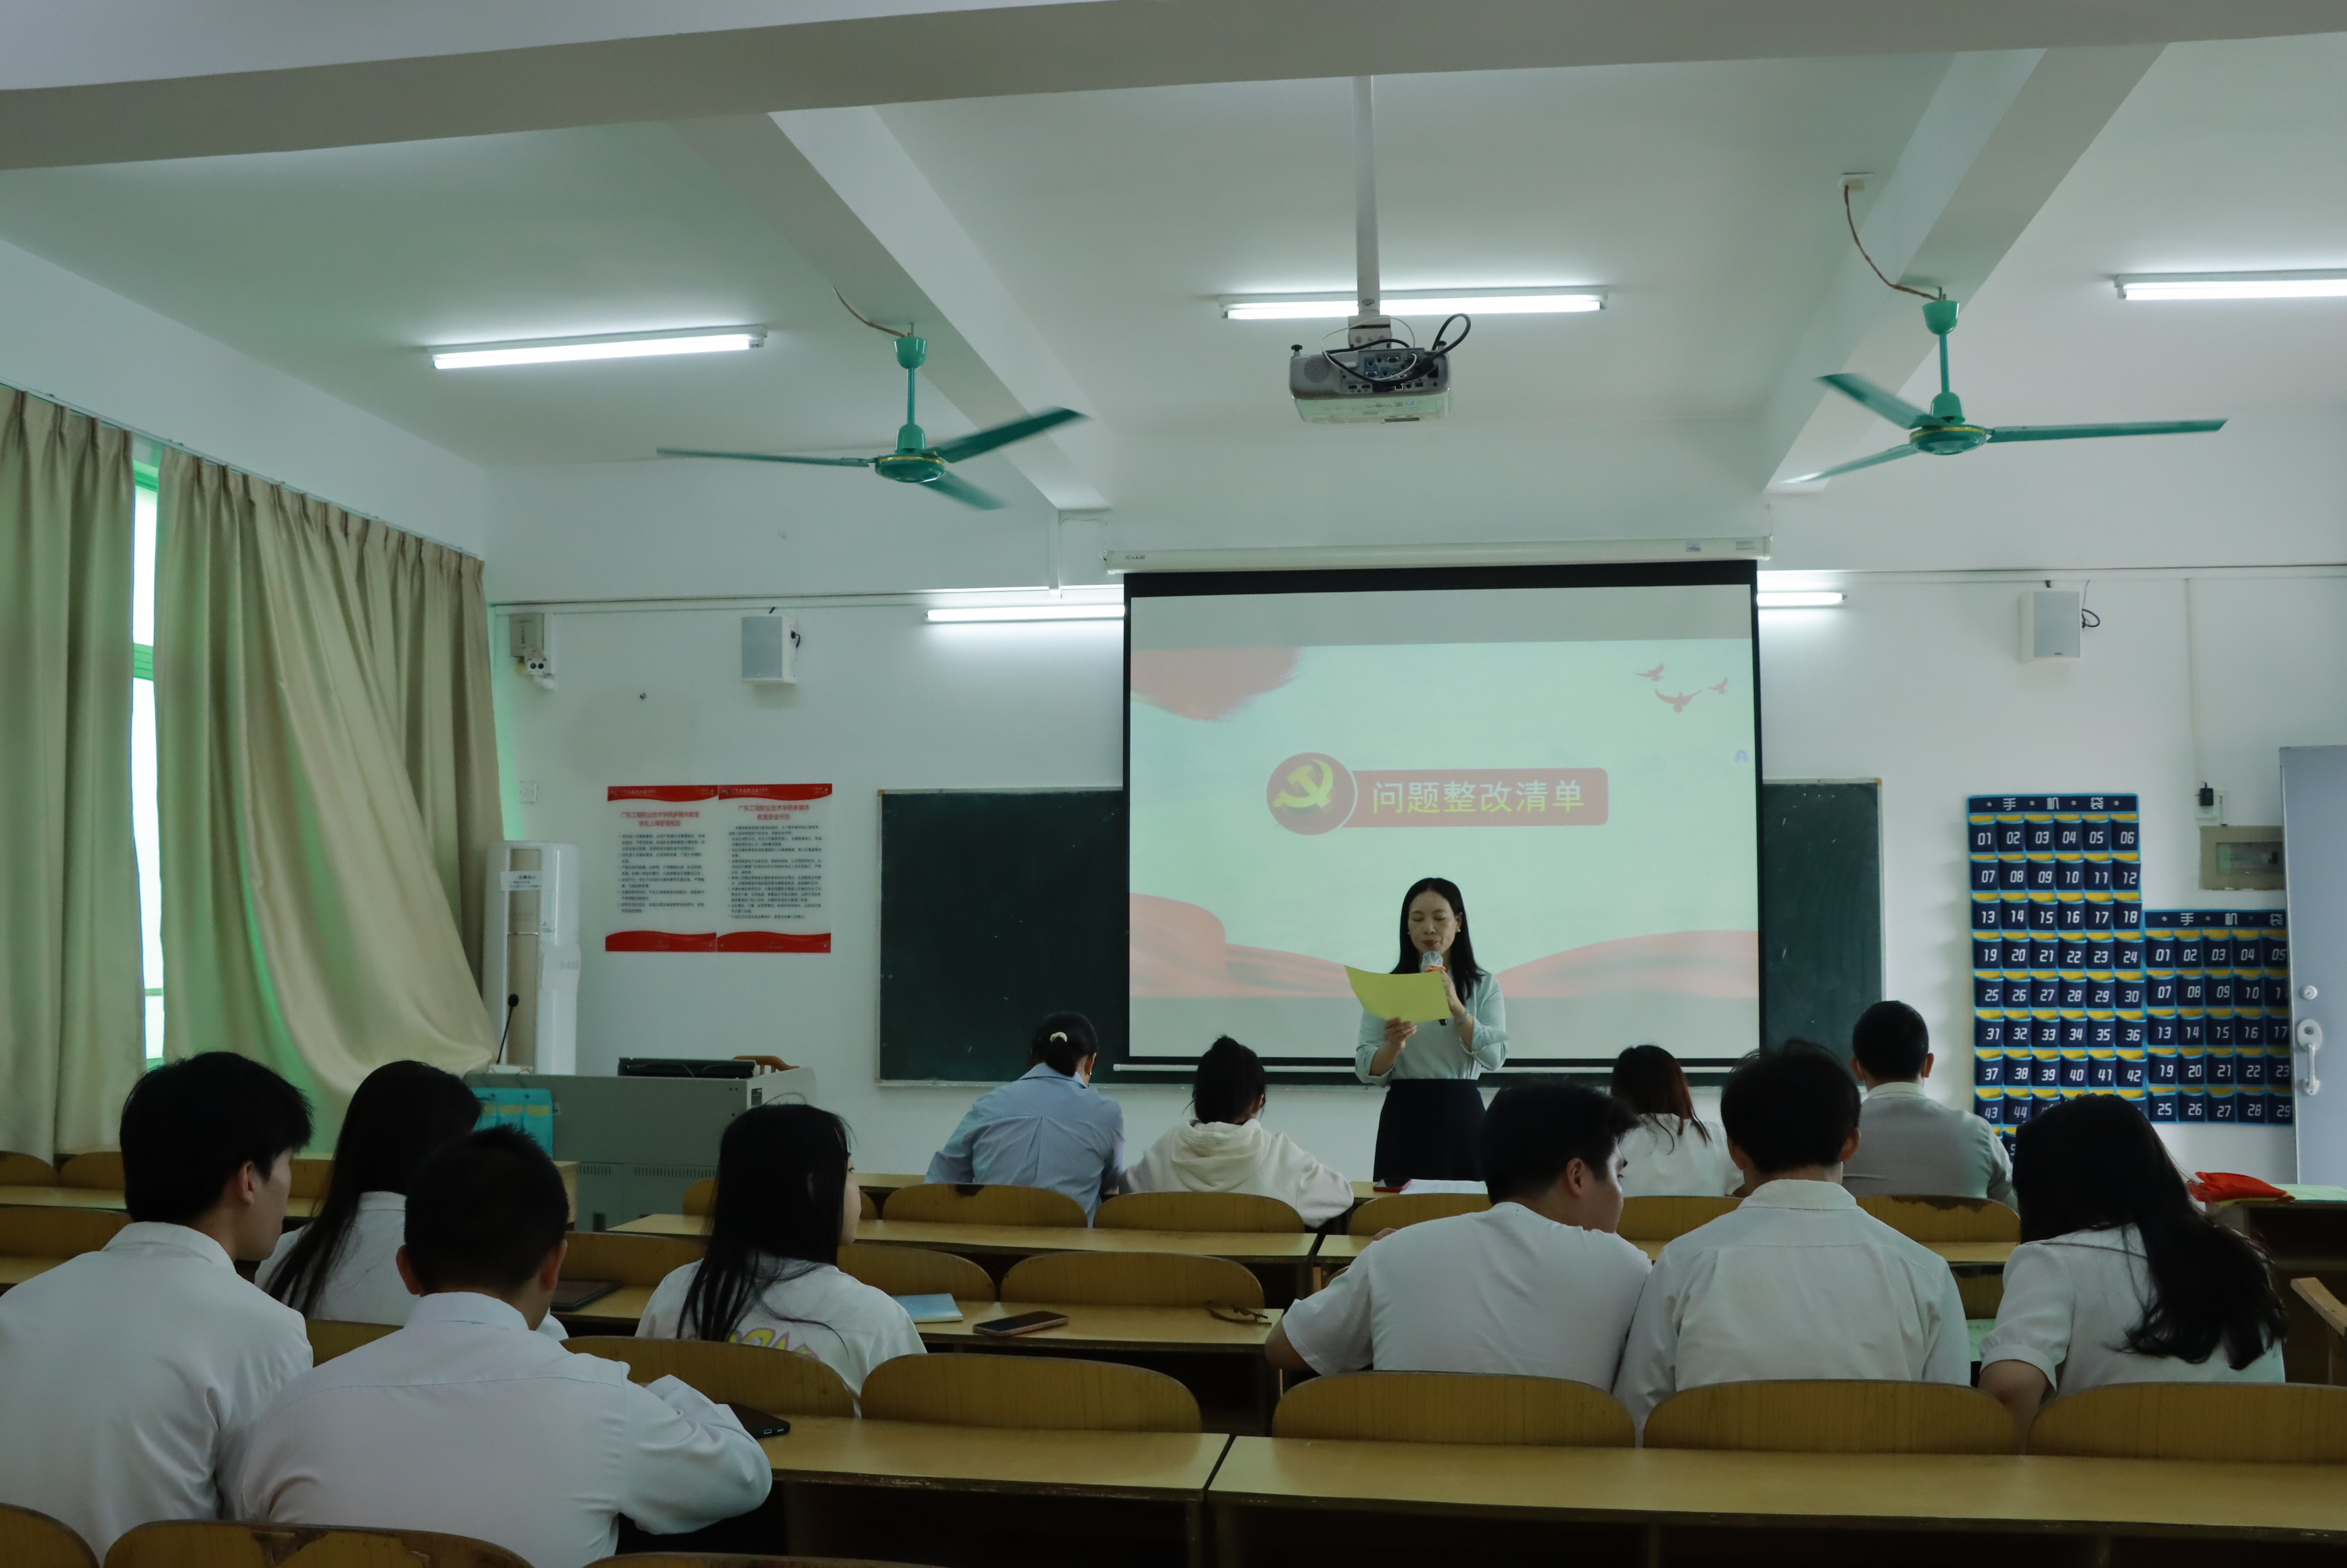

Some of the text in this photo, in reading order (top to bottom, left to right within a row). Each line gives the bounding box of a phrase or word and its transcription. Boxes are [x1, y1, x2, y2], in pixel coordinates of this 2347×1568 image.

[1372, 779, 1585, 814] 问题整改清单
[2002, 796, 2104, 811] 手机袋
[1977, 831, 2135, 846] 01 02 03 04 05 06
[1981, 870, 2137, 885] 07 08 09 10 11 12
[1981, 910, 2138, 924] 13 14 15 16 17 18
[2180, 912, 2283, 926] 手机袋
[1984, 948, 2138, 964] 19 20 21 22 23 24
[2155, 948, 2286, 962] 01 02 03 04 05
[1985, 989, 2139, 1003] 25 26 27 28 29 30
[2157, 985, 2172, 999] 07
[2187, 985, 2201, 998] 08
[2216, 985, 2230, 998] 09
[2246, 986, 2260, 999] 10
[1985, 1027, 2141, 1042] 31 32 33 34 35 36
[2158, 1025, 2289, 1039] 13 14 15 16 17
[1985, 1067, 2142, 1082] 37 38 39 40 41 42
[2160, 1064, 2290, 1078] 19 20 21 22 23
[1985, 1106, 1998, 1119] 43
[2014, 1106, 2028, 1119] 44
[2157, 1102, 2291, 1118] 25 26 27 28 29
